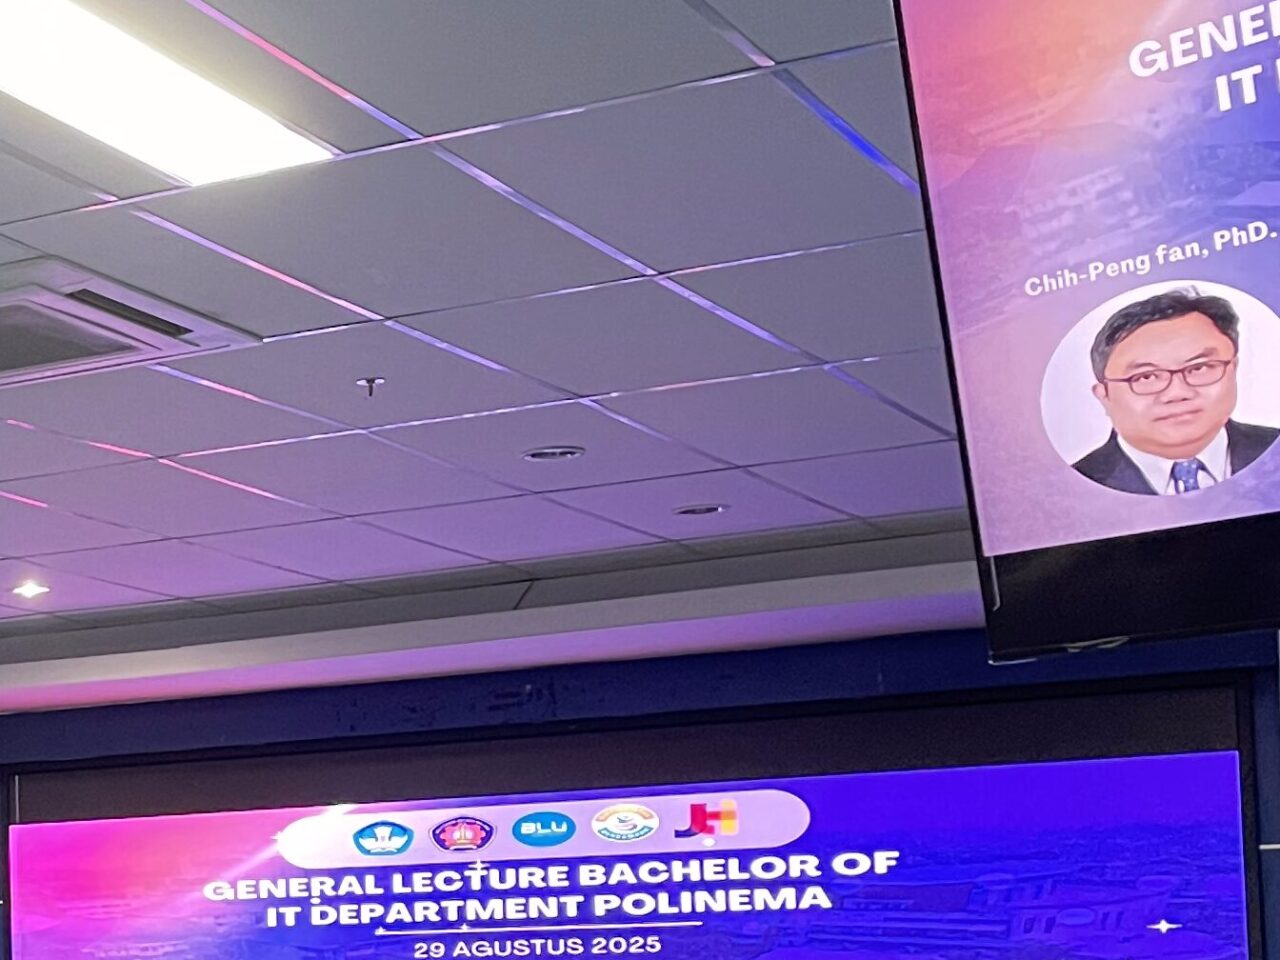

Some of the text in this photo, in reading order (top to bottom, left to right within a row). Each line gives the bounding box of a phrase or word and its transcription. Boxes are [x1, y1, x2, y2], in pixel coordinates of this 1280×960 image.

[1216, 64, 1263, 112] IT
[1024, 221, 1278, 296] Chih-Peng fan, PhD.
[520, 820, 568, 835] BLU
[202, 850, 900, 902] GENERAL LECTURE BACHELOR OF
[266, 886, 832, 928] IT DEPARTMENT POLINEMA
[414, 935, 662, 959] 29 AGUSTUS 2025
